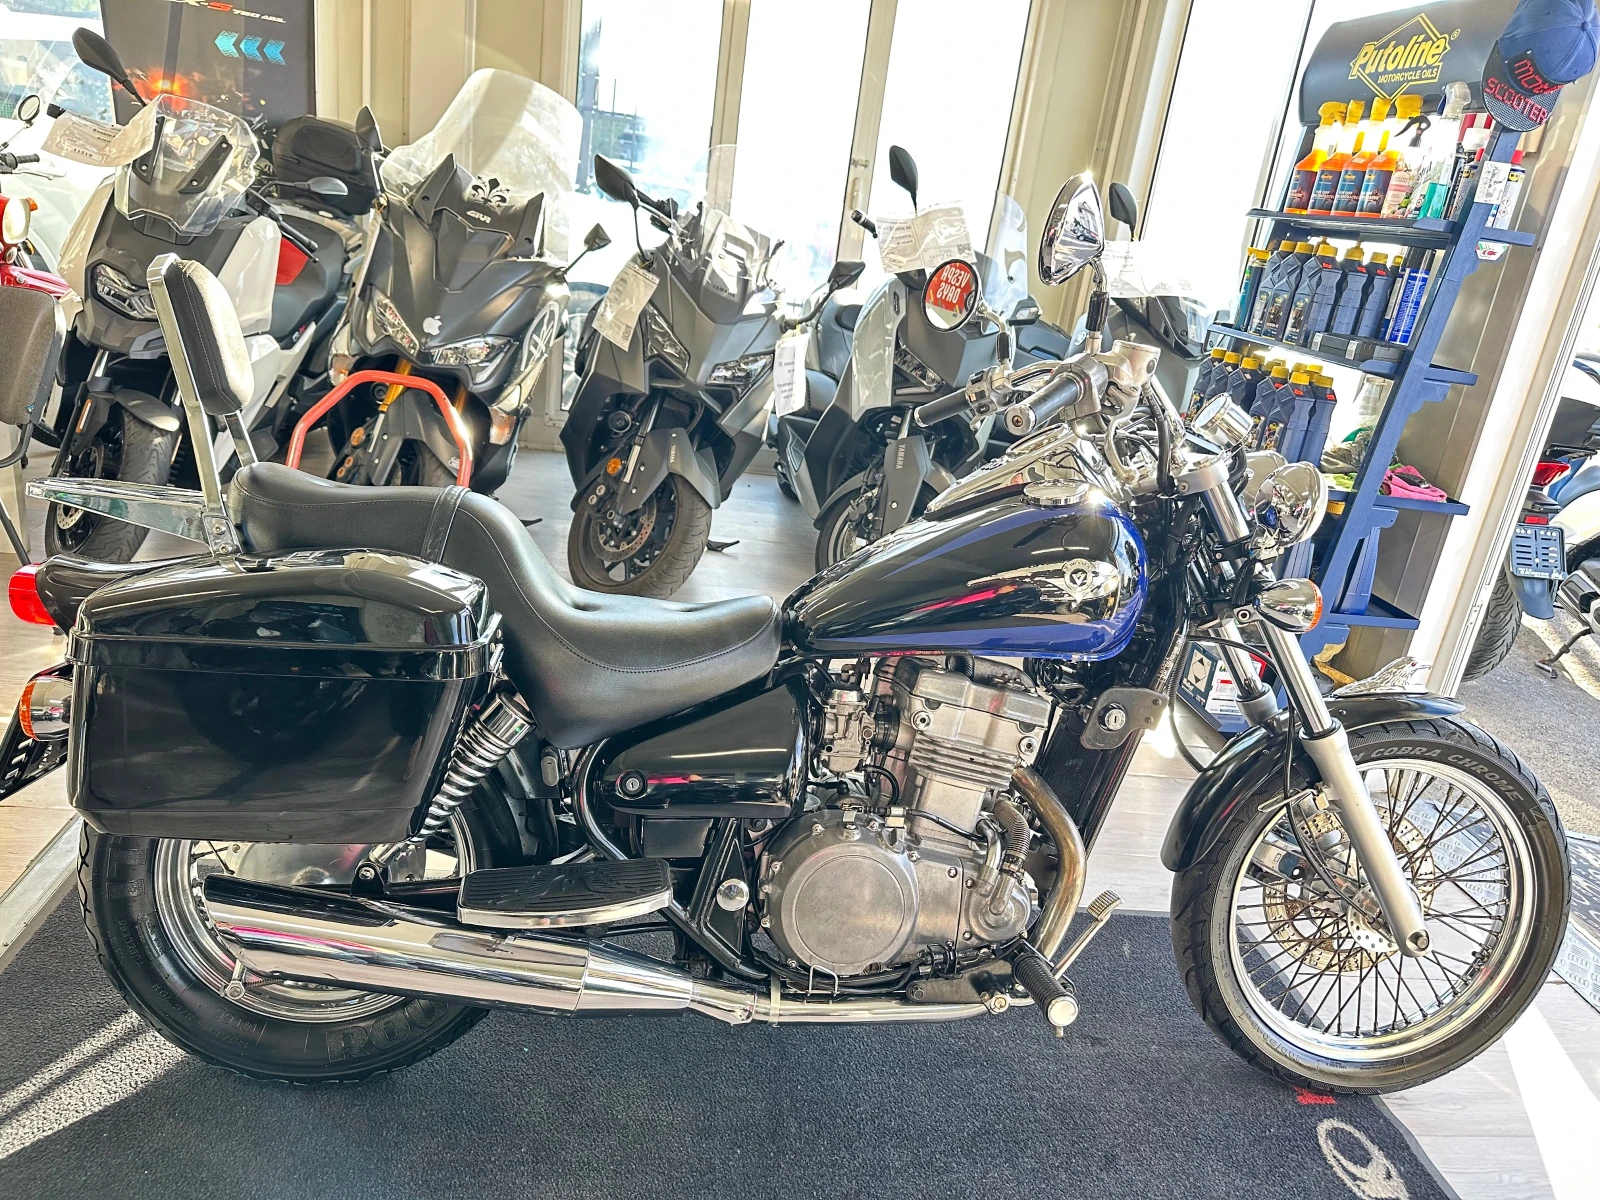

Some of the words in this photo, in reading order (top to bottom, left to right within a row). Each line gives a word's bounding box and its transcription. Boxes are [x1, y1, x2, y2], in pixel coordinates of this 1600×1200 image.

[1350, 33, 1446, 76] Putoline
[1377, 69, 1421, 84] MOTORCYCLE
[1421, 67, 1438, 79] OILS
[1513, 58, 1565, 94] MO
[1483, 77, 1549, 126] SCOOTER
[466, 210, 492, 224] GIVI
[712, 284, 736, 298] YAMAHA
[895, 444, 906, 470] YAMAHA
[1370, 746, 1443, 758] COBRA
[1447, 753, 1525, 802] CHROME
